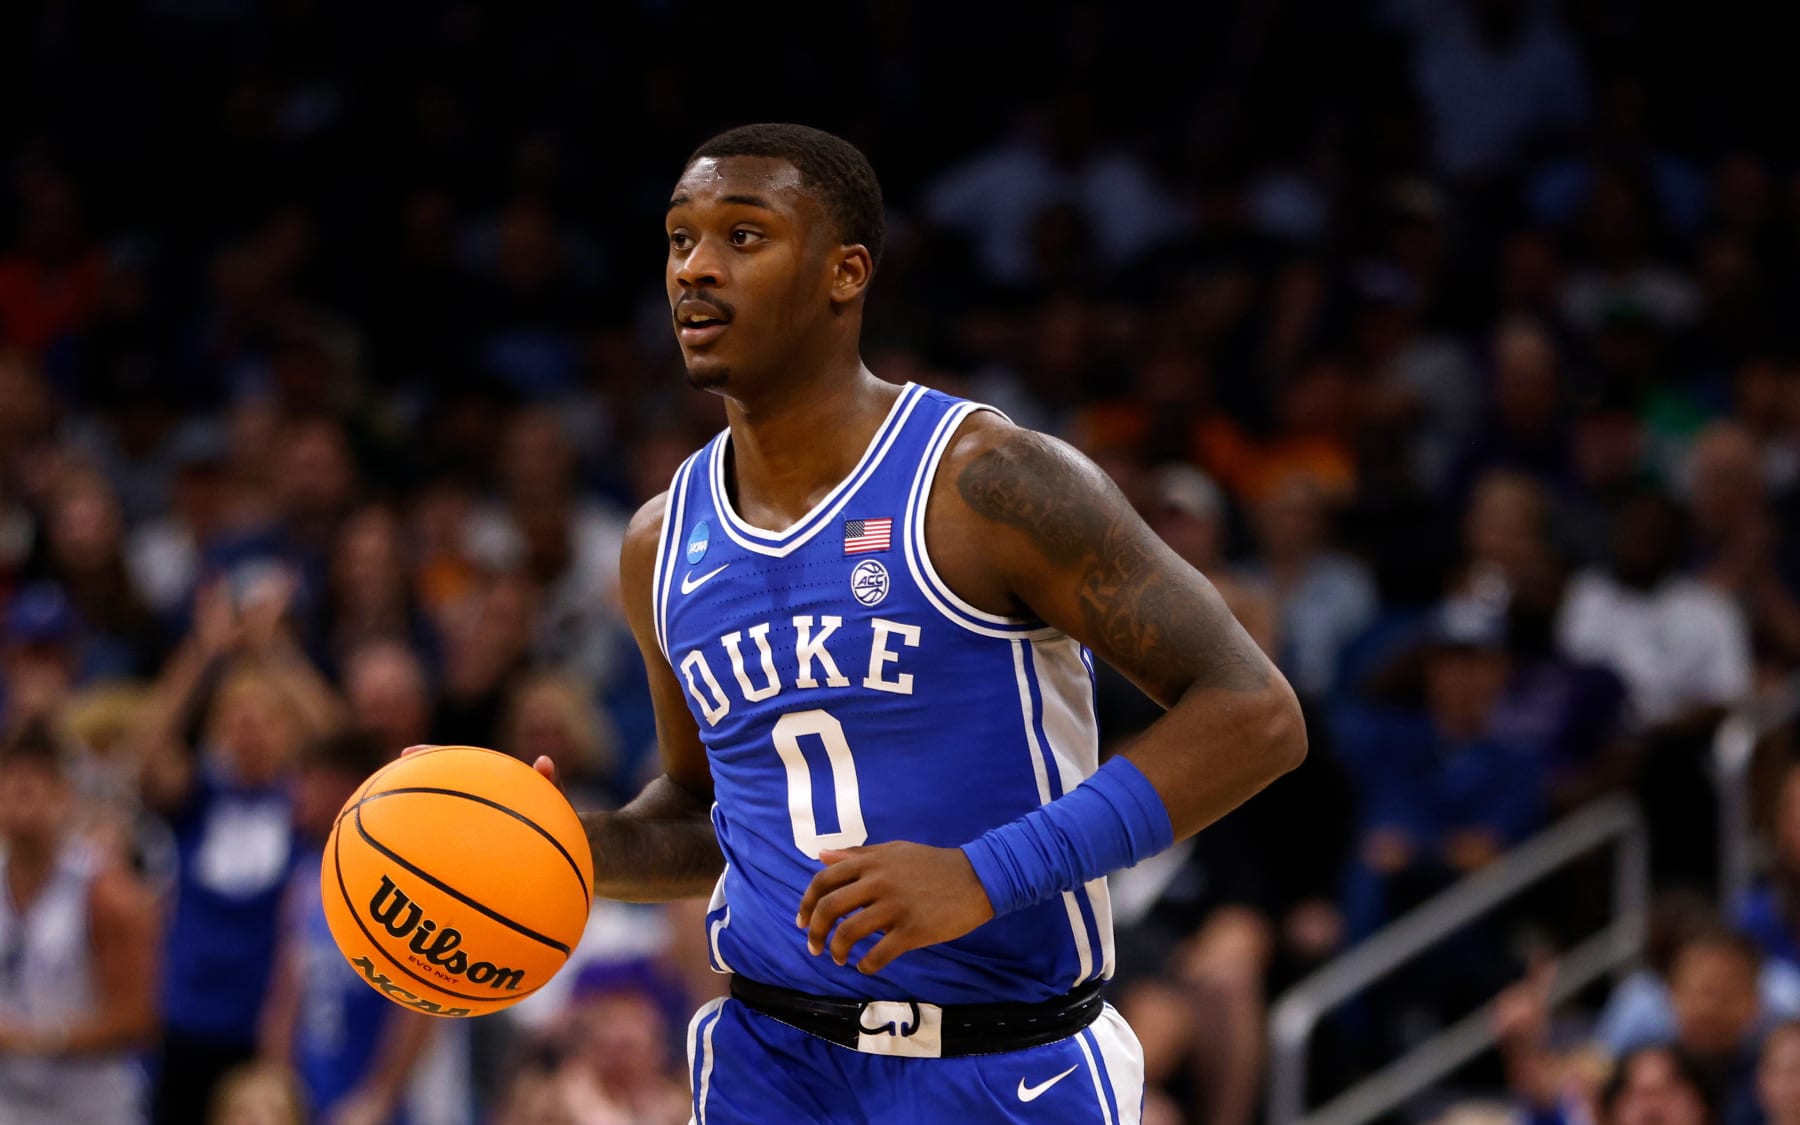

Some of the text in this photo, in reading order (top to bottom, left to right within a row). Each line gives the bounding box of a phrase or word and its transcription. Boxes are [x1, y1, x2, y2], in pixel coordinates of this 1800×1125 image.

[857, 574, 884, 587] ACC
[680, 615, 921, 727] DUKE
[772, 709, 868, 861] 0
[369, 874, 526, 991] Wilson
[408, 955, 459, 985] EVO NXT
[351, 956, 472, 1017] NCAA
